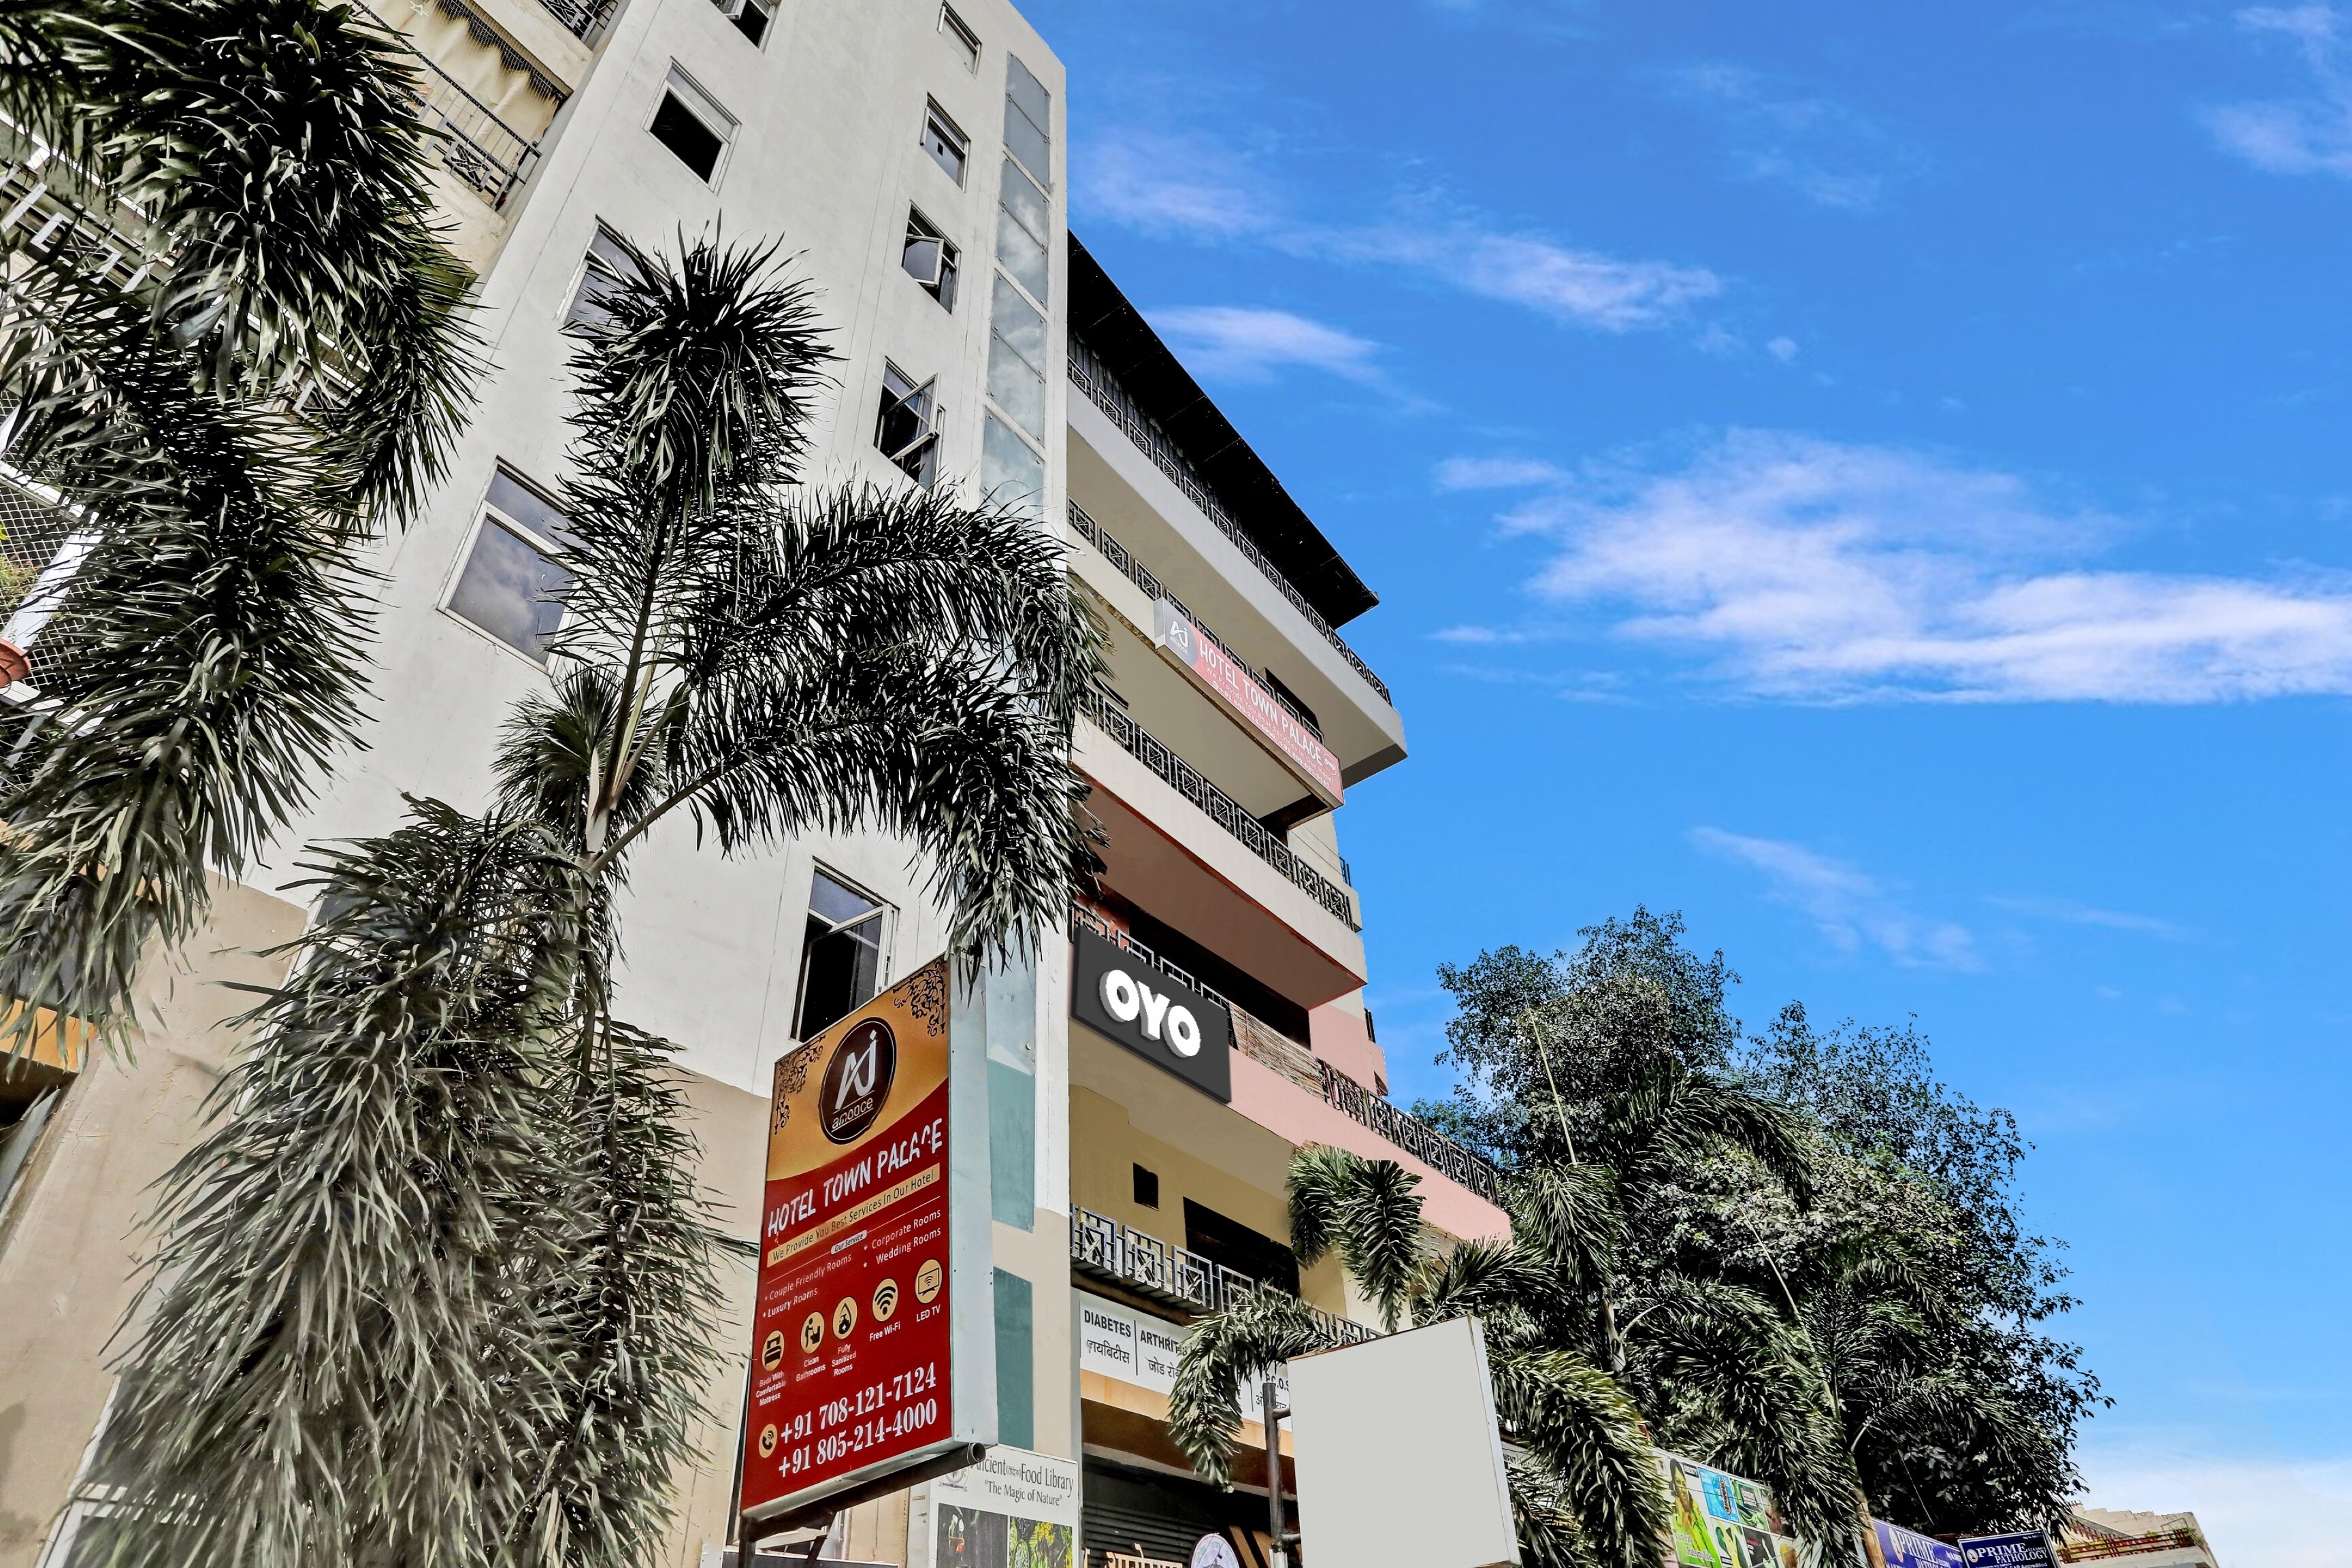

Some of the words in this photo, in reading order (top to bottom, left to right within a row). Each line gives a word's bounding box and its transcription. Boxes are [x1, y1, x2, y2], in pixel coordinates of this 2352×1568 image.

[1199, 638, 1239, 691] HOTEL
[1242, 678, 1278, 727] TOWN
[1281, 714, 1322, 766] PALACE
[1099, 969, 1201, 1058] OYO
[767, 1188, 817, 1238] HOTEL
[823, 1156, 871, 1207] TOWN
[772, 1246, 785, 1262] We
[786, 1232, 814, 1258] Provide
[815, 1226, 830, 1241] You
[831, 1214, 848, 1232] Best
[849, 1198, 882, 1225] Services
[883, 1193, 891, 1206] In
[893, 1183, 909, 1200] Our
[910, 1169, 934, 1191] Hotel
[870, 1224, 912, 1250] Corporate
[913, 1209, 942, 1229] Rooms
[834, 1241, 845, 1254] Our
[844, 1233, 864, 1249] Service
[875, 1241, 912, 1266] Wedding
[913, 1227, 942, 1248] Rooms
[769, 1279, 795, 1301] Couple
[795, 1263, 826, 1289] Friendly
[826, 1254, 852, 1272] Rooms
[766, 1301, 792, 1319] Luxury
[792, 1287, 818, 1306] Rooms
[915, 1307, 931, 1323] LED
[931, 1303, 941, 1317] TV
[868, 1328, 883, 1343] Free
[883, 1321, 901, 1337] Wi-Fi
[1084, 1309, 1132, 1338] DIABETES
[837, 1343, 851, 1356] Fully
[1140, 1329, 1188, 1356] ARTHRIT
[795, 1362, 826, 1383] Bathrooms
[802, 1355, 819, 1369] Clean
[831, 1350, 858, 1368] Sanitized
[833, 1362, 853, 1377] Rooms
[755, 1379, 787, 1399] Comfortable
[758, 1376, 772, 1388] Beds
[758, 1392, 781, 1407] Mattress
[780, 1409, 813, 1445] +91
[818, 1361, 937, 1431] 708-121-7124
[777, 1443, 811, 1479] +91
[816, 1397, 938, 1466] 805-214-4000
[985, 1479, 1002, 1495] "The
[1004, 1484, 1026, 1503] Magic
[1027, 1488, 1036, 1501] of
[1036, 1490, 1062, 1506] Nature"
[1021, 1463, 1042, 1485] Food
[1045, 1468, 1073, 1498] Library
[1895, 1529, 1938, 1565] PRIME
[1976, 1542, 2029, 1558] PRIME
[1994, 1549, 2048, 1564] PATHOLOGY
